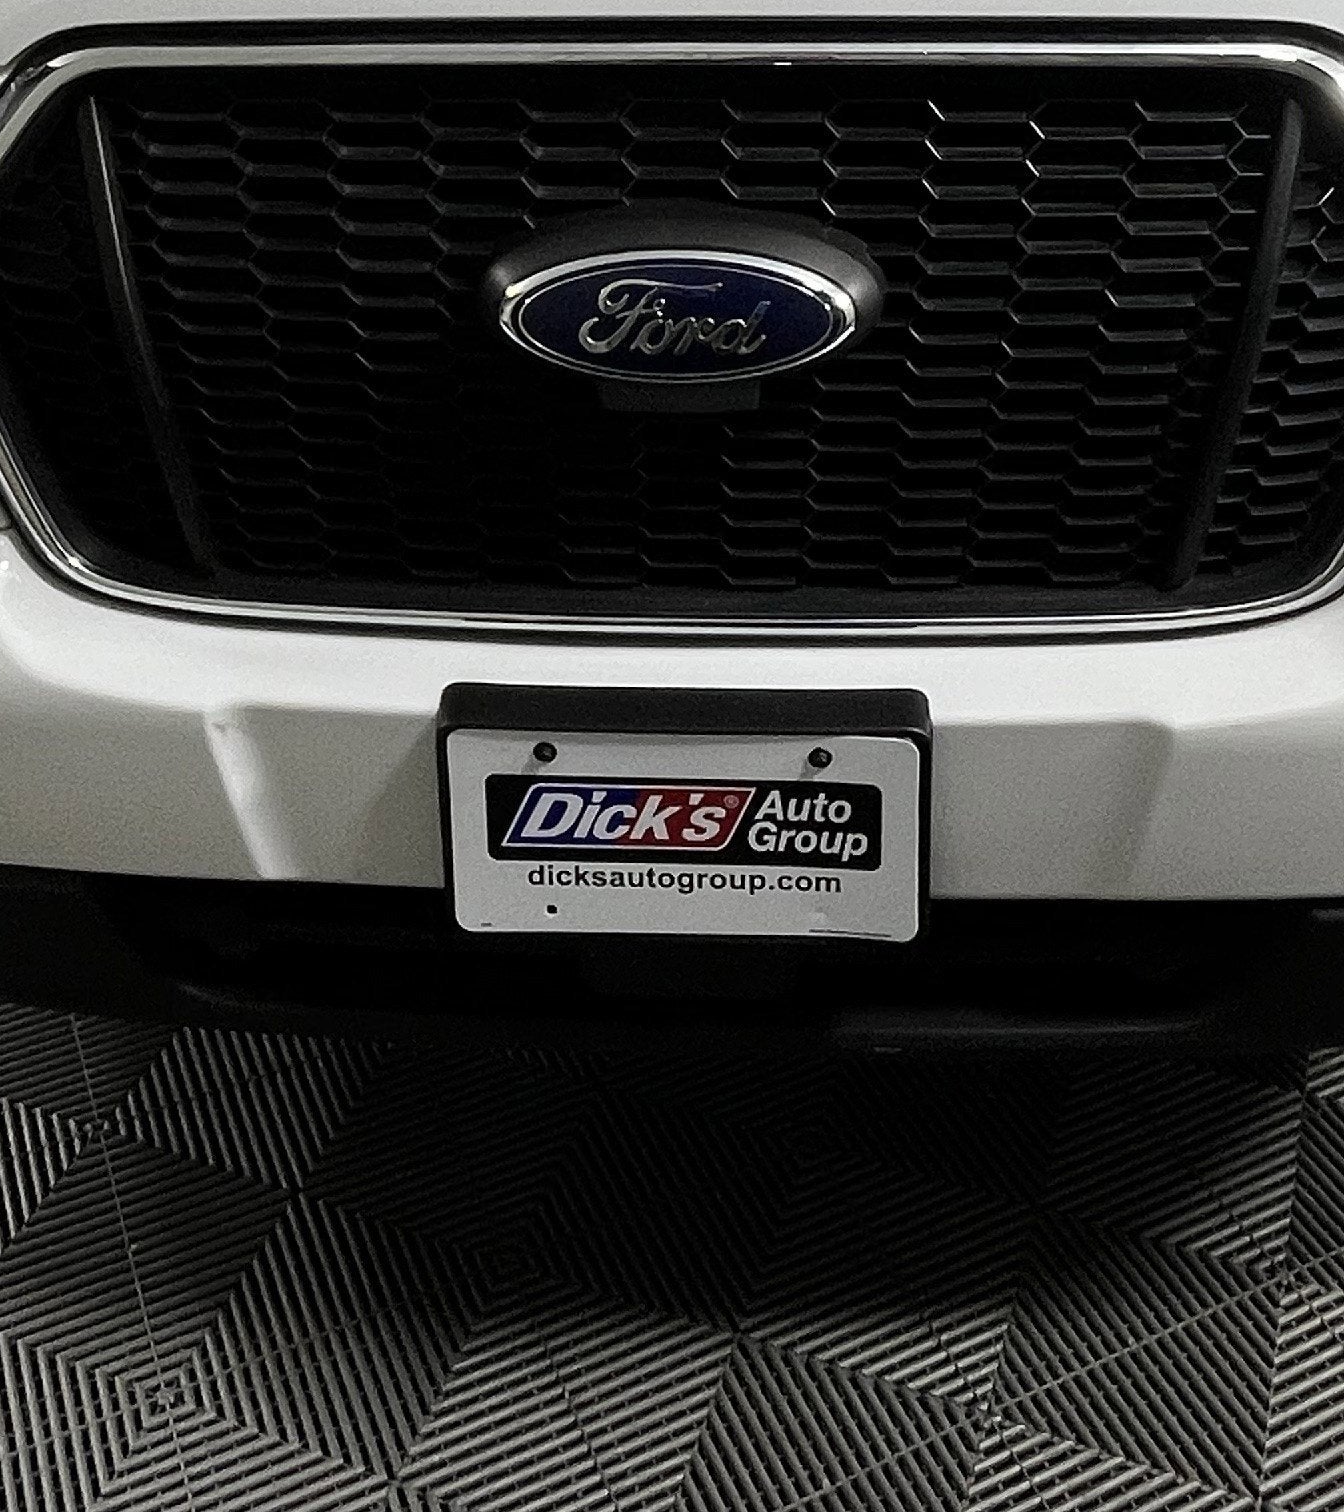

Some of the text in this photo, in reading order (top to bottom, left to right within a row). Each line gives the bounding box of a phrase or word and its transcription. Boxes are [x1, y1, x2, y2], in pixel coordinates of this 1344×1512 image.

[578, 278, 772, 355] Ford
[520, 790, 727, 842] Dick's
[754, 790, 853, 824] Auto
[748, 820, 869, 863] Group
[527, 864, 842, 896] dicksautogroup.com
